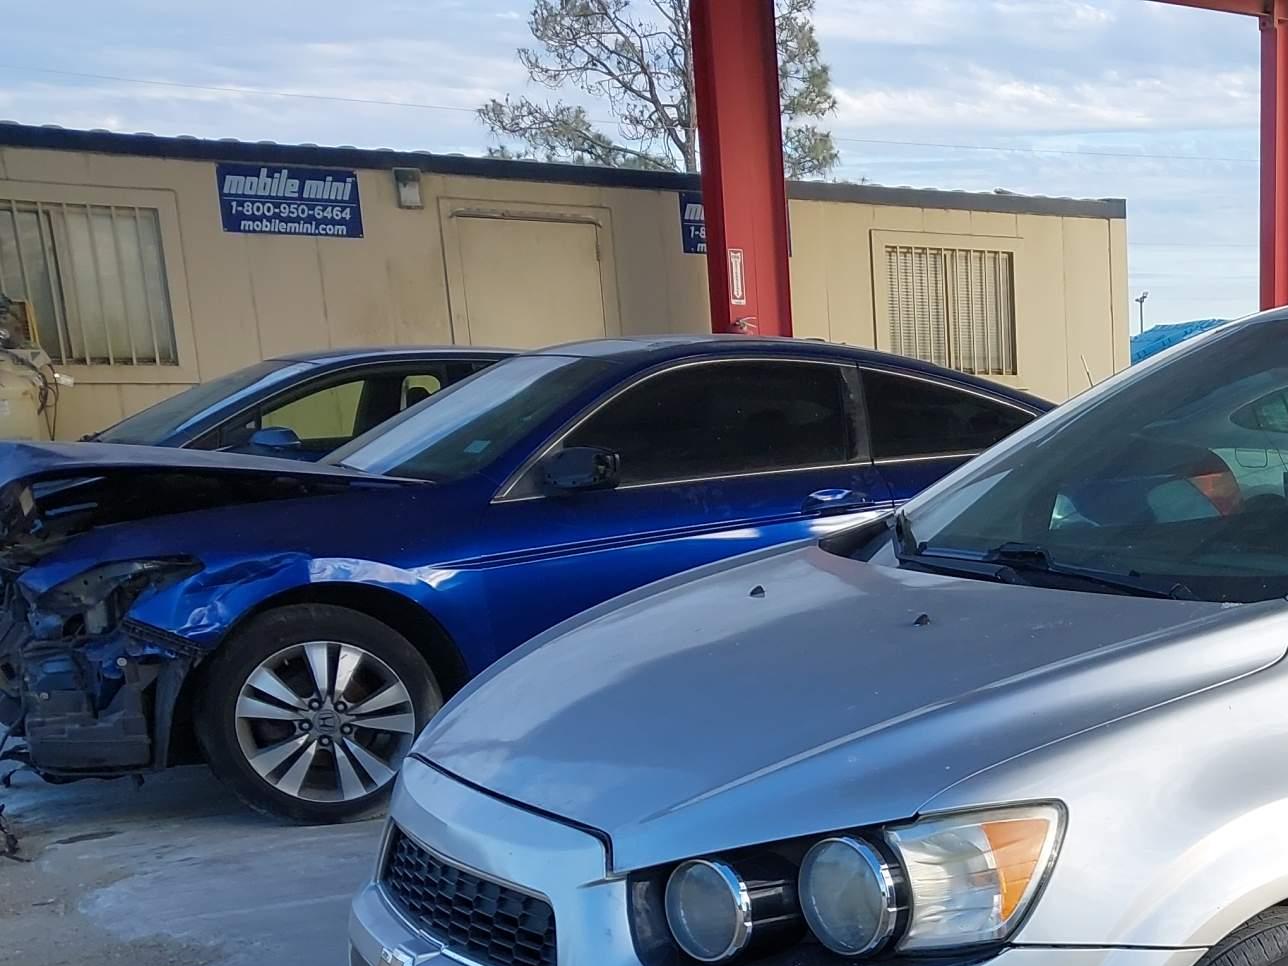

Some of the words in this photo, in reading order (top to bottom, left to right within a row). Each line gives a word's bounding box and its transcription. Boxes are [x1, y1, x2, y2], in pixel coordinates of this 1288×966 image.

[223, 168, 299, 198] mobile
[303, 176, 353, 200] mini
[231, 201, 351, 220] 1-800-950-6464
[240, 219, 347, 235] mobilemini.com
